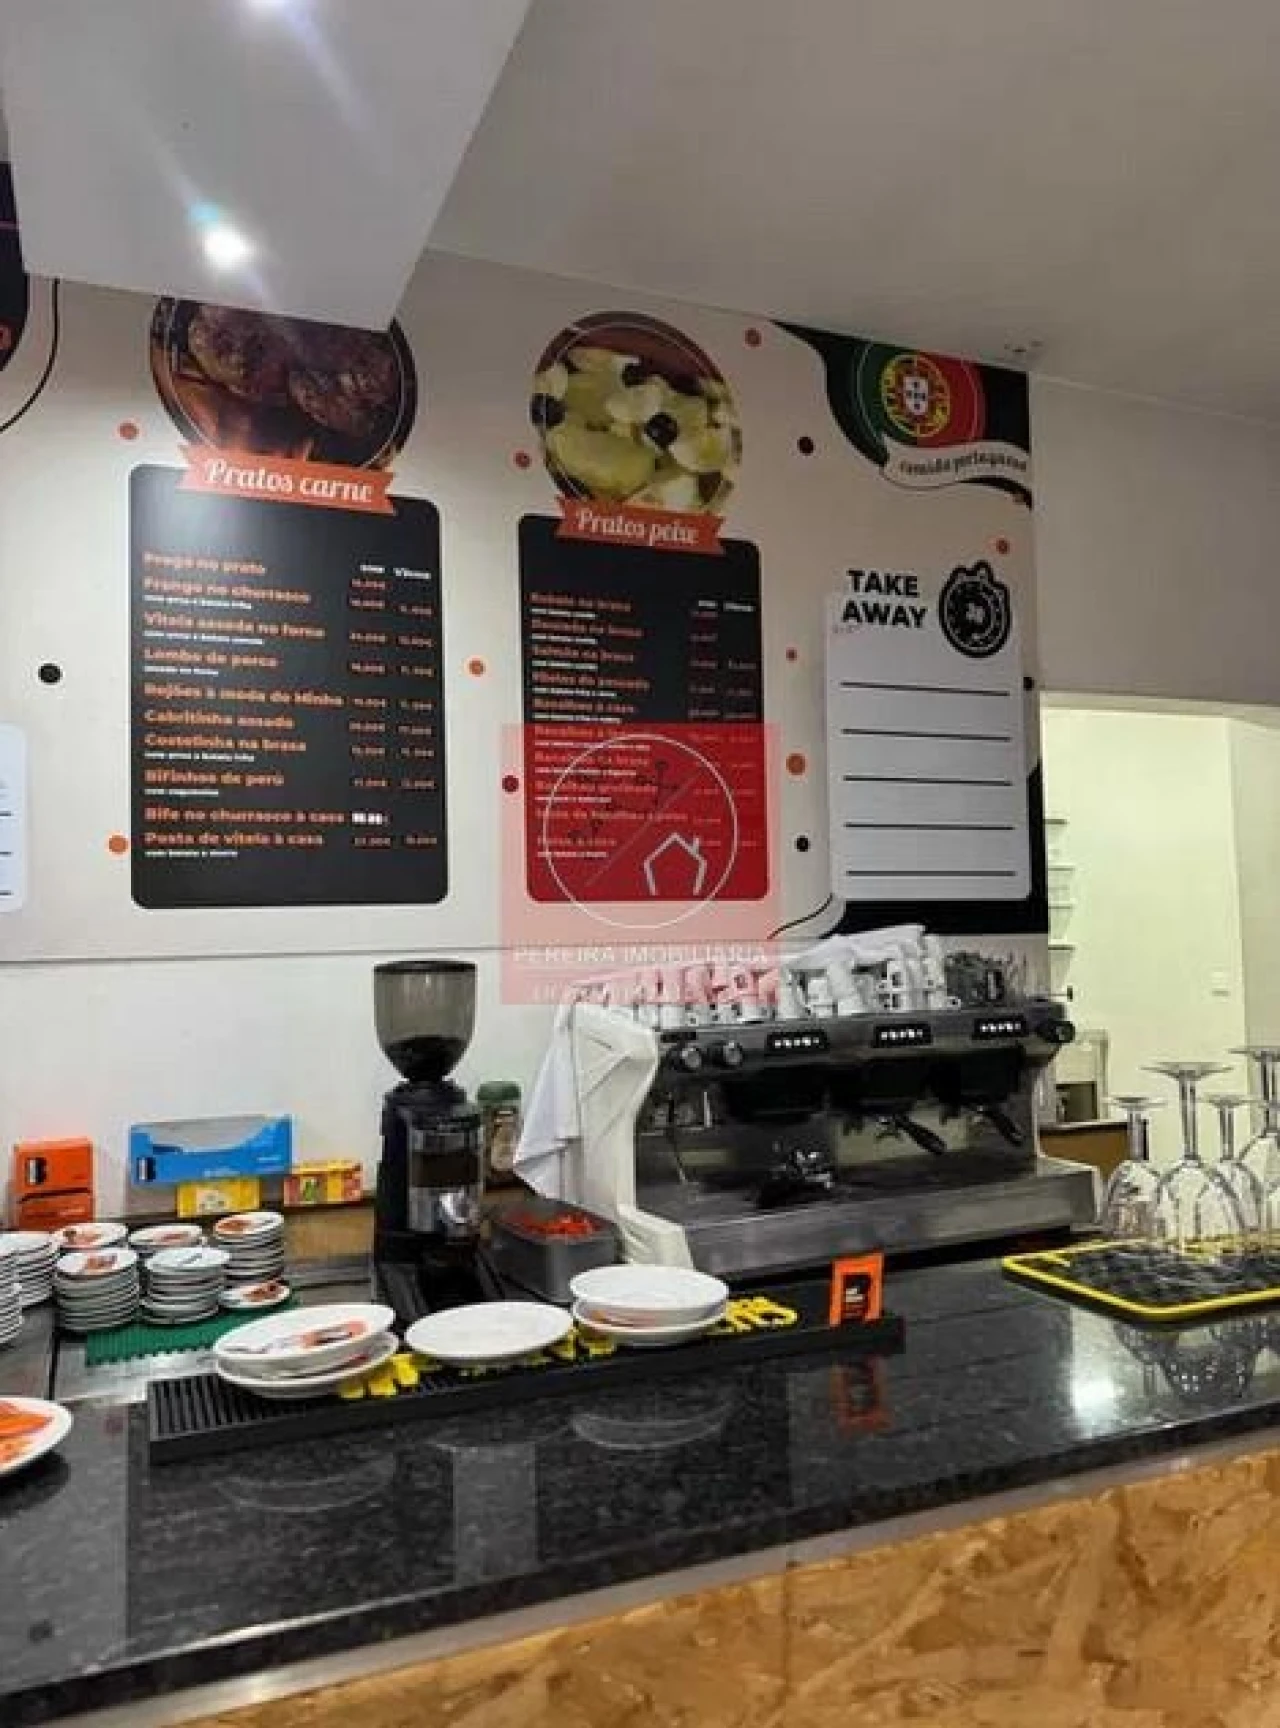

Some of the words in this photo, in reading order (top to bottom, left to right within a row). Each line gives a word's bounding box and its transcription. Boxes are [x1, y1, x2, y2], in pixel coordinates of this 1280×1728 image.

[206, 457, 293, 493] Pratos
[300, 477, 373, 503] carne
[577, 507, 645, 538] Pratos
[651, 521, 700, 547] peixe
[144, 576, 202, 596] Frango
[847, 569, 920, 597] TAKE
[144, 611, 194, 628] Vitela
[842, 599, 928, 628] AWAY
[144, 648, 202, 664] Lombo
[206, 650, 228, 664] de
[231, 654, 278, 670] porco
[144, 806, 180, 822] Bife
[144, 831, 195, 846] Posta
